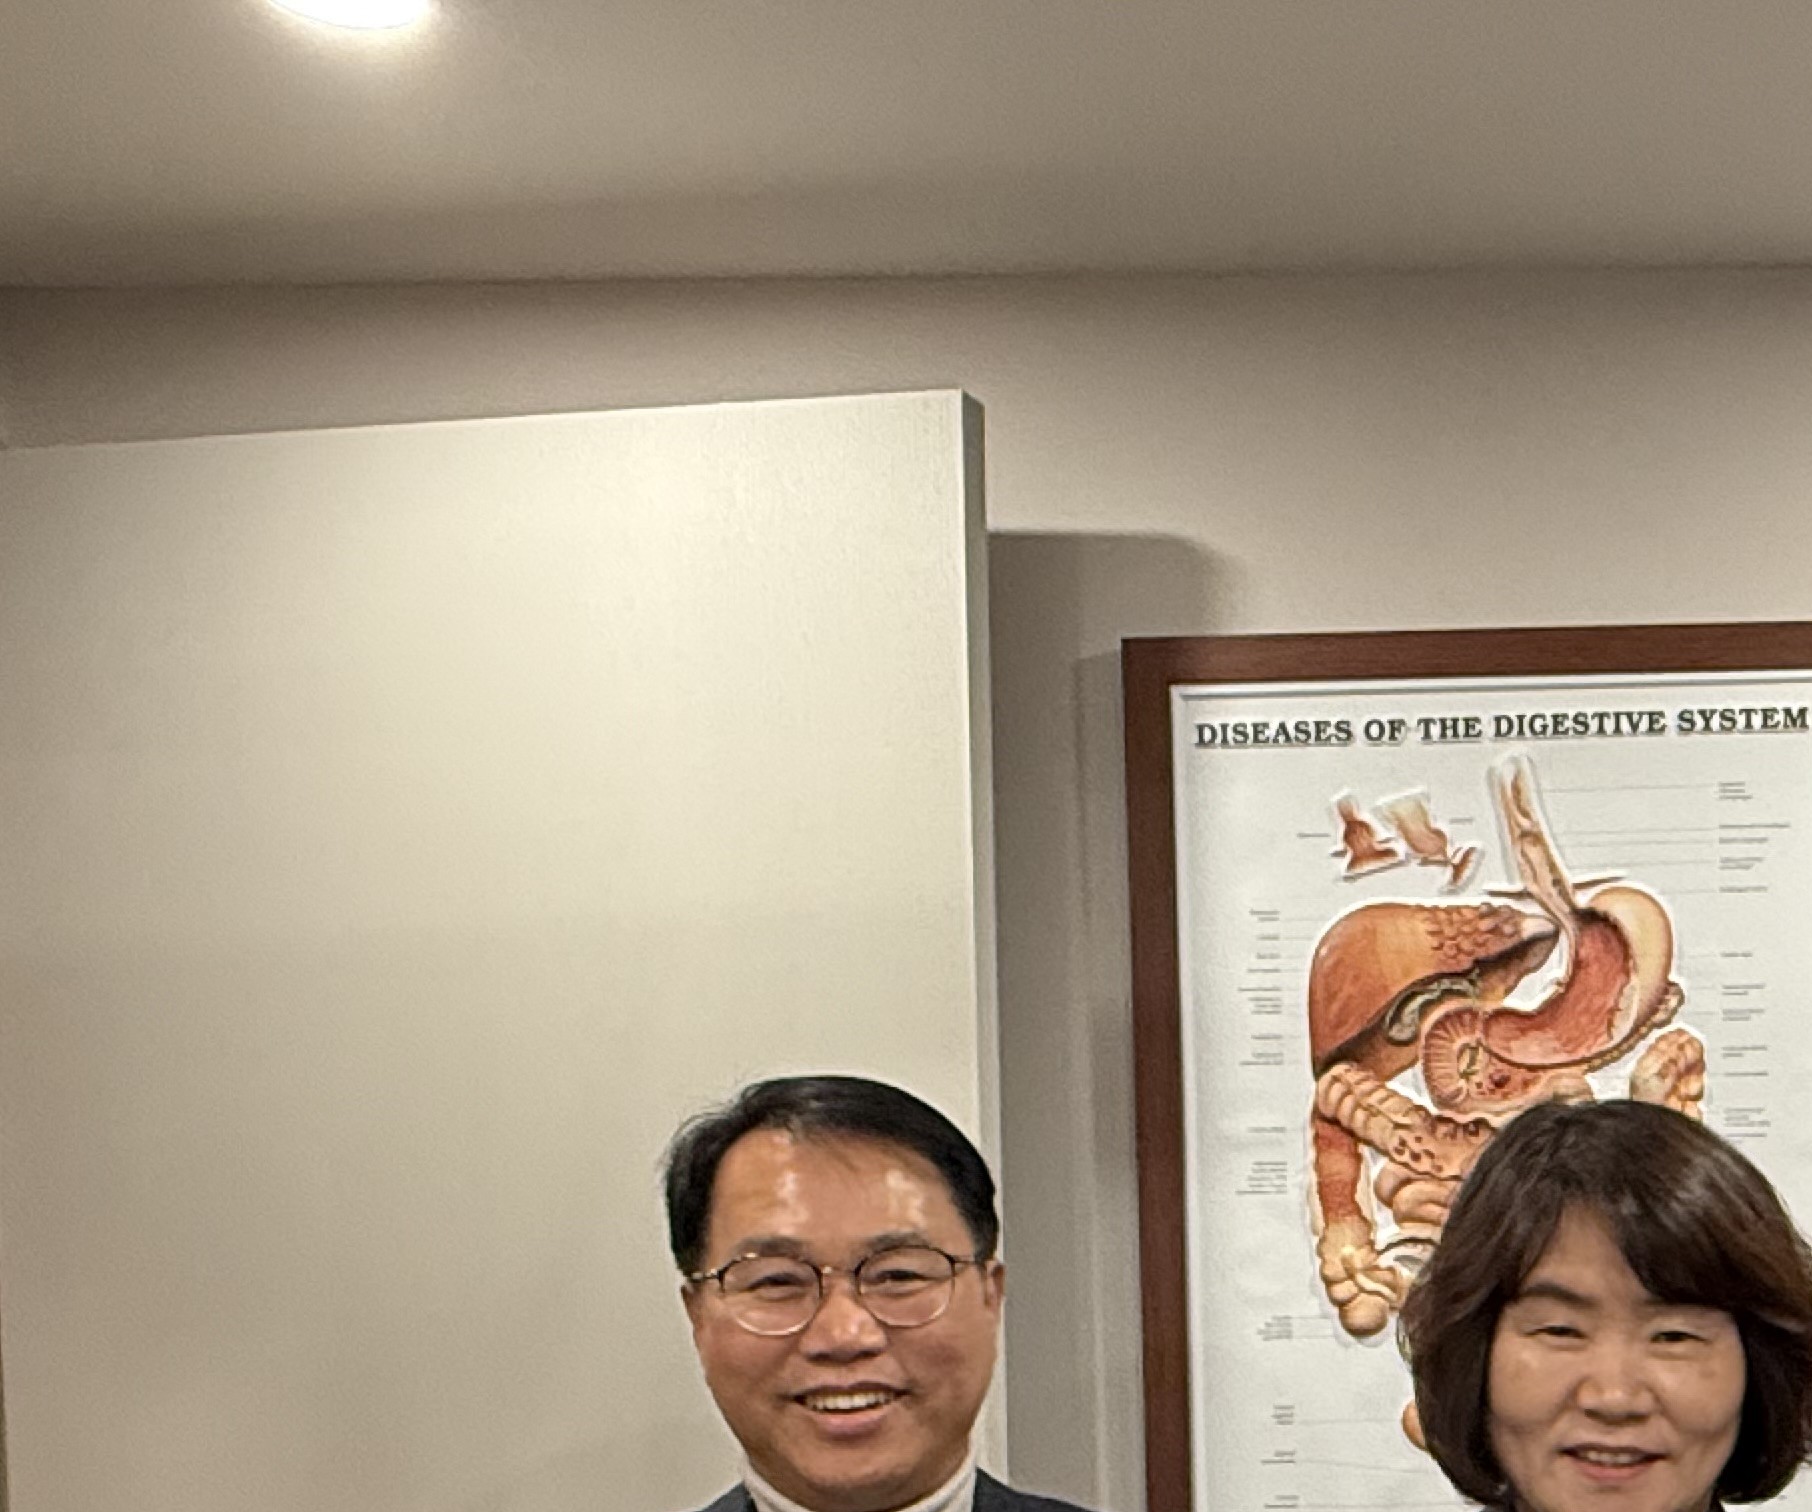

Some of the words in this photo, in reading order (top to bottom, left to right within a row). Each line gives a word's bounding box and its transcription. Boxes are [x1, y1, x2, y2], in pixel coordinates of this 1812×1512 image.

[1195, 719, 1354, 747] DISEASES
[1364, 718, 1406, 743] OF
[1417, 716, 1483, 740] THE
[1494, 710, 1668, 738] DIGESTIVE
[1676, 706, 1810, 733] SYSTEM
